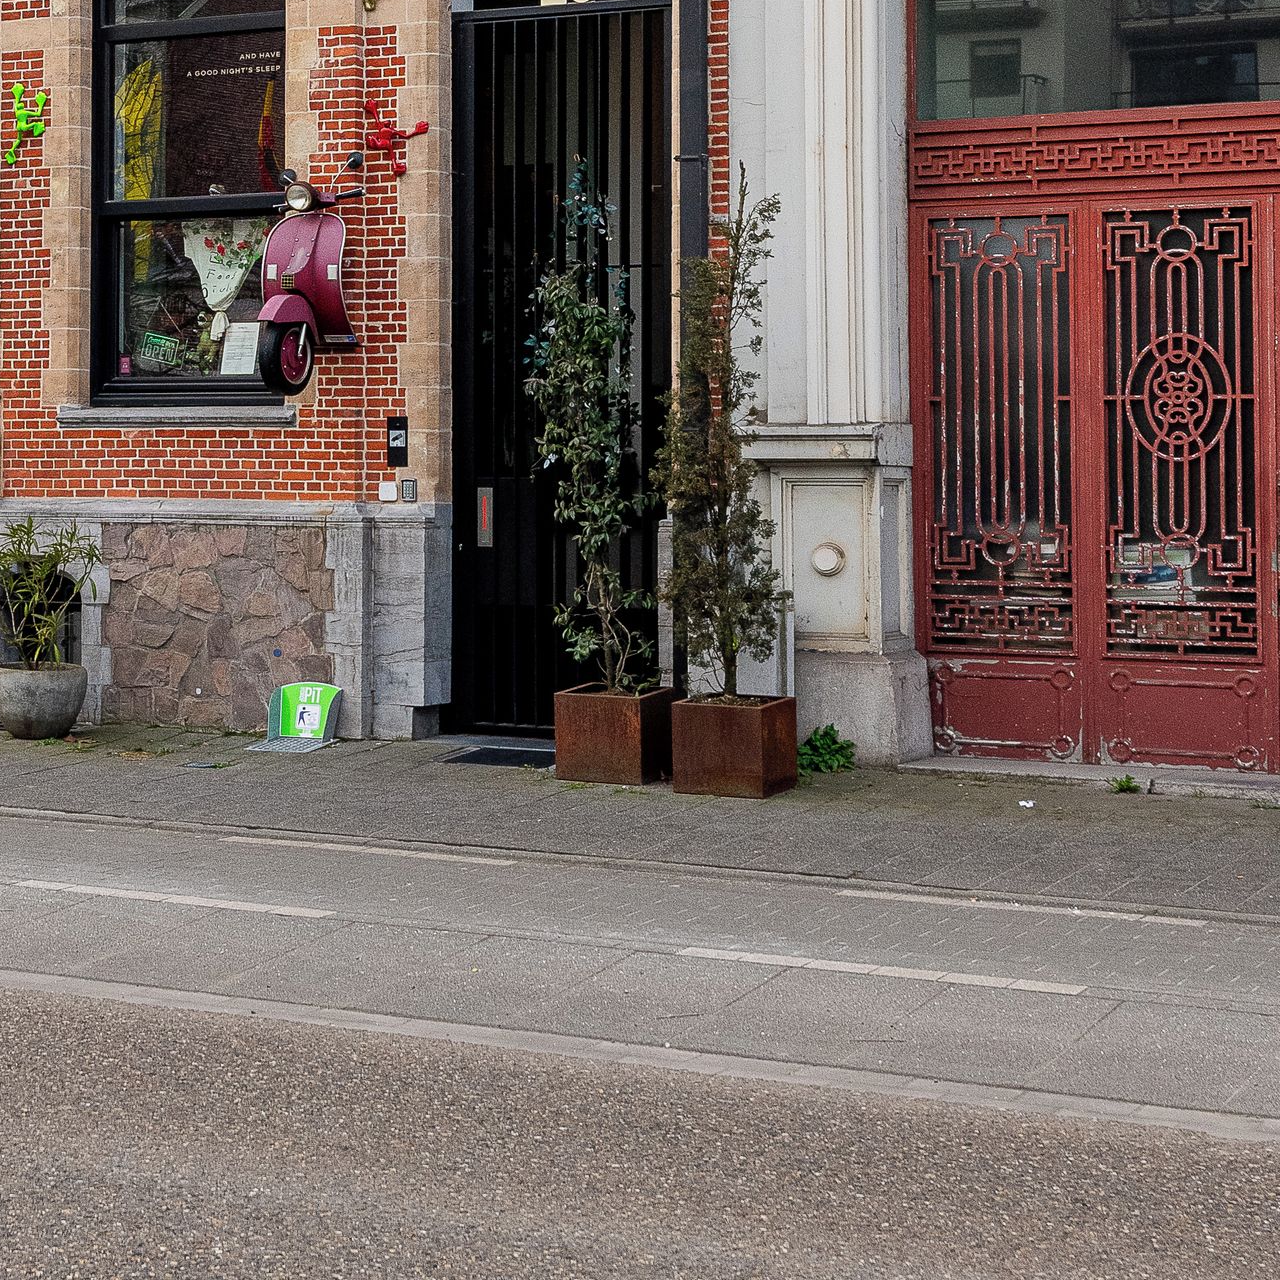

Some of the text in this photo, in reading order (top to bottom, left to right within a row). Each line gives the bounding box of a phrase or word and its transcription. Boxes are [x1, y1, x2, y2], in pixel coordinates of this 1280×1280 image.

[194, 69, 219, 77] GOOD
[220, 66, 253, 75] NIGHT'S
[255, 65, 281, 73] SLEEP
[145, 343, 174, 361] OPEN
